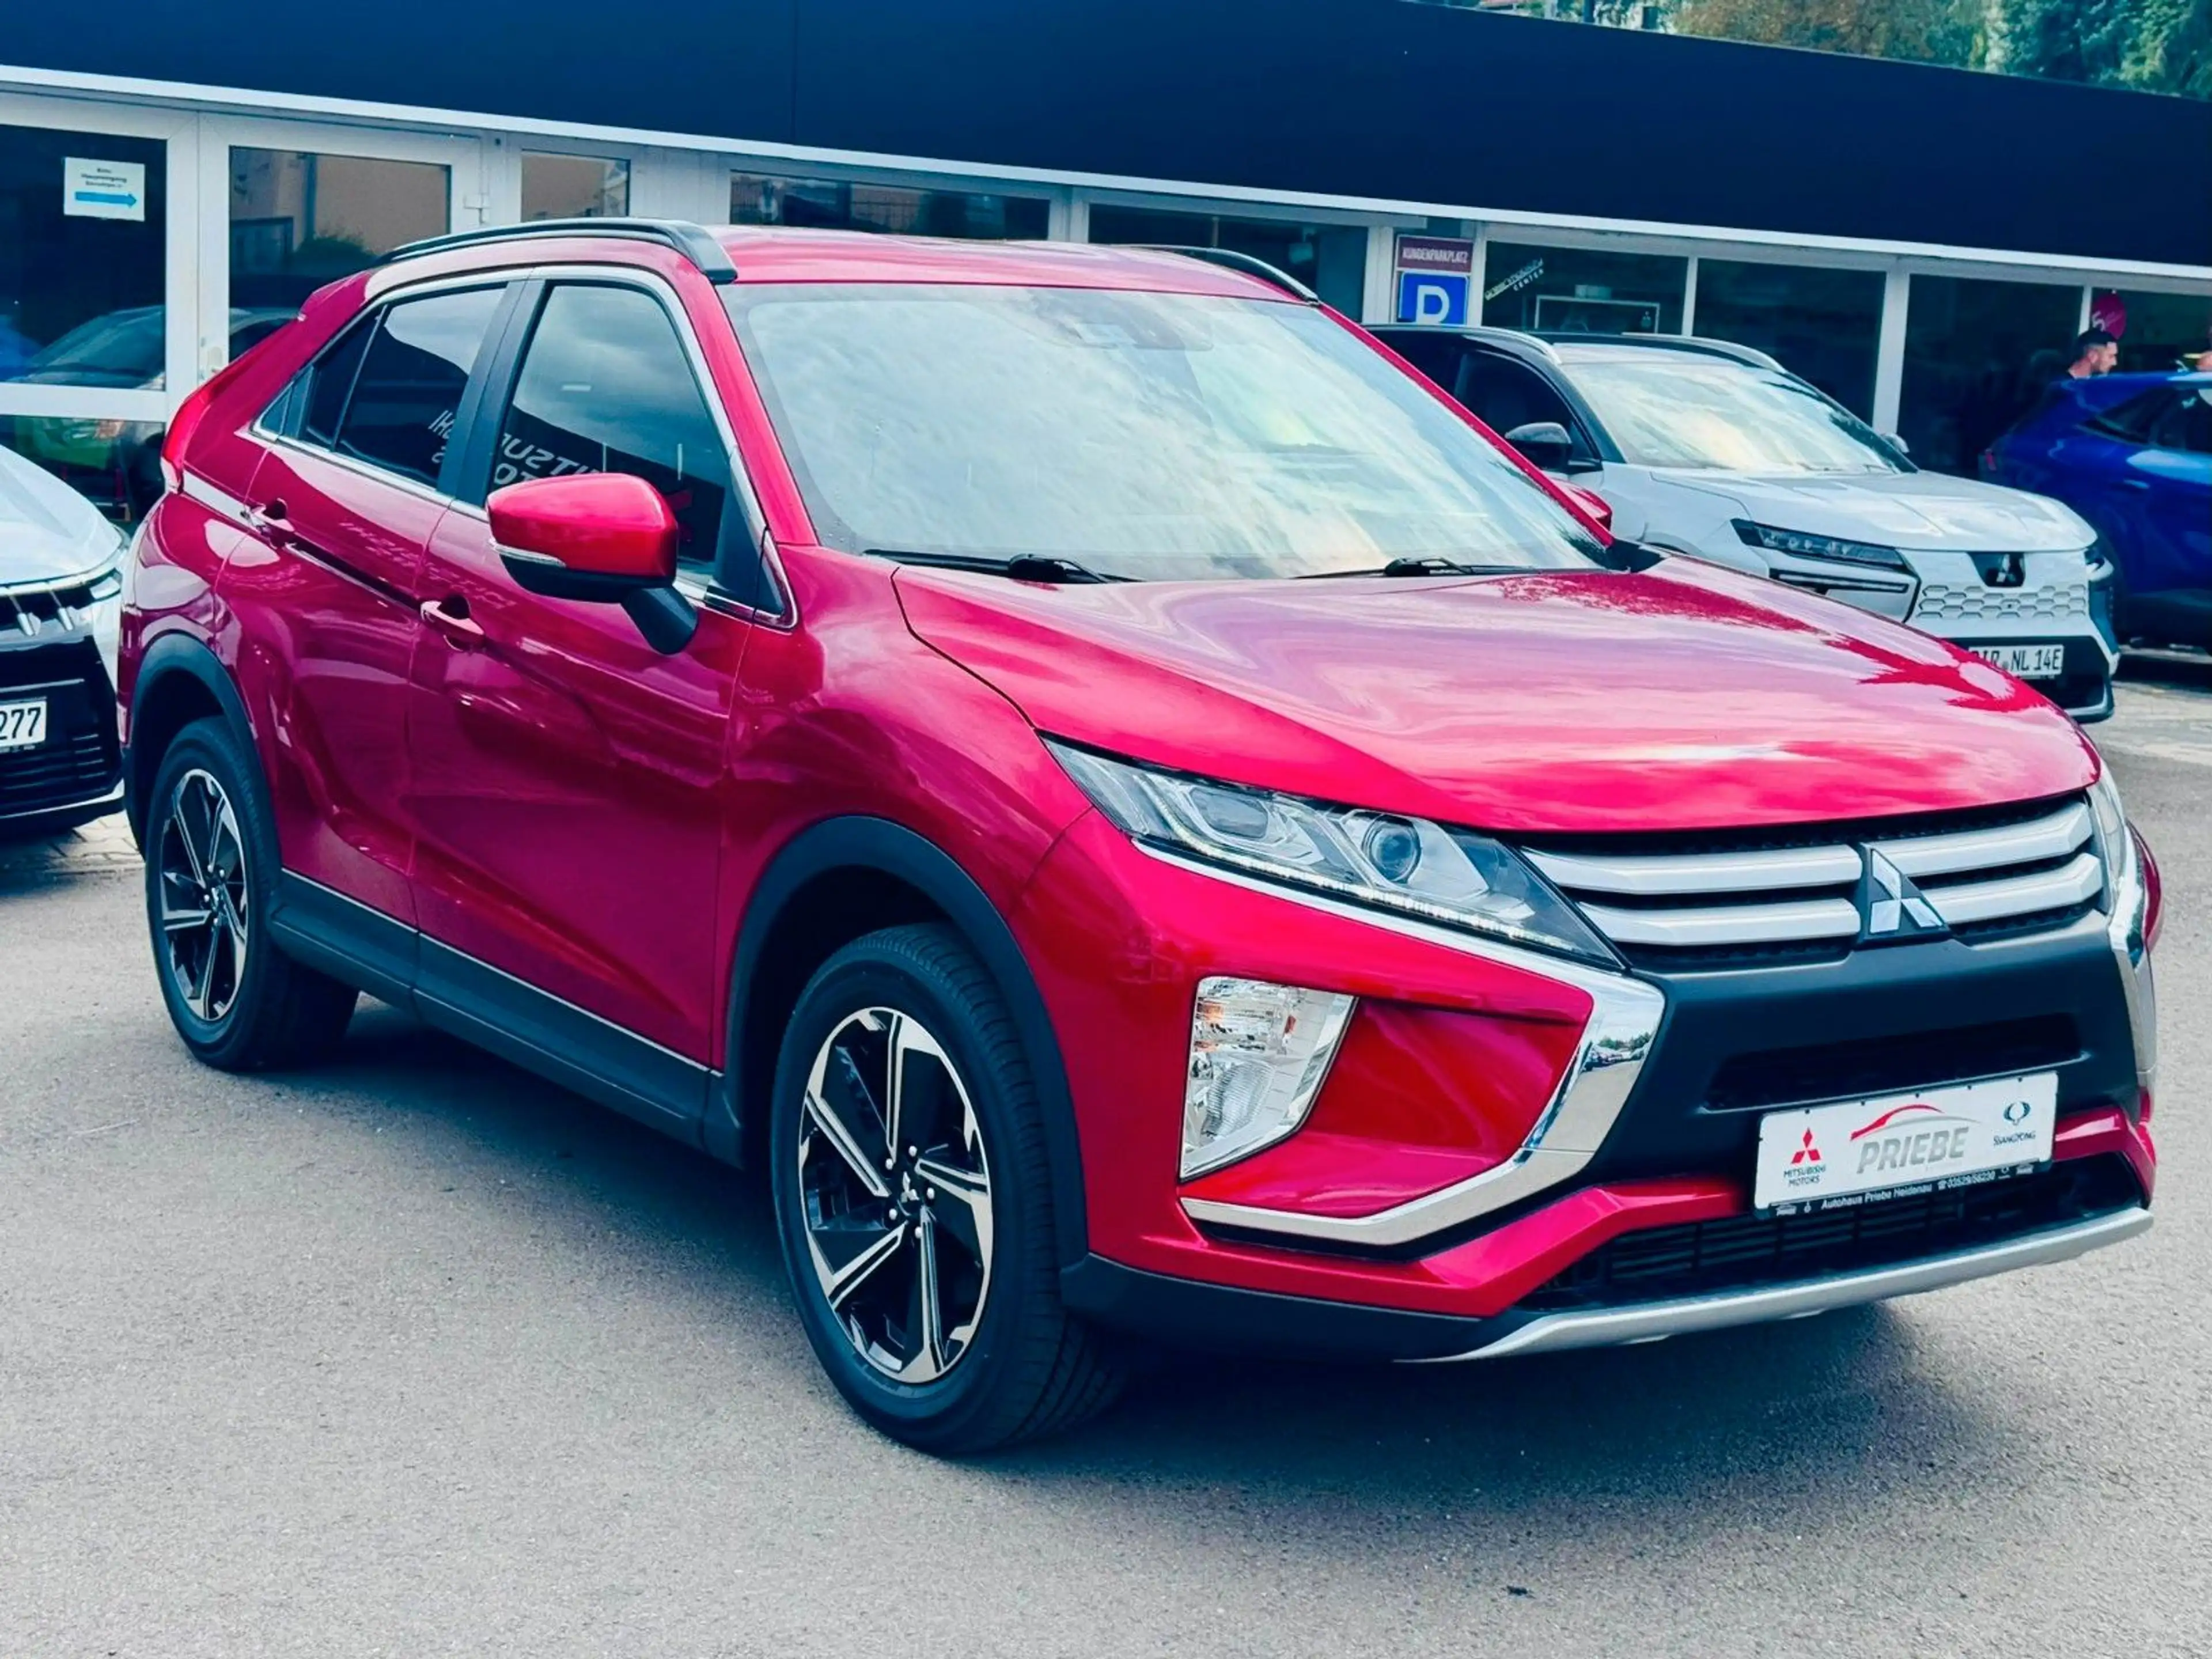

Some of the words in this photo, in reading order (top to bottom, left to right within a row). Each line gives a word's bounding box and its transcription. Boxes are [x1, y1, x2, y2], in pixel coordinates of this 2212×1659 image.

[1416, 285, 1450, 325] P
[2012, 650, 2029, 671] NL
[2033, 648, 2061, 671] 14E
[1857, 1127, 1969, 1174] PRIEBE
[1789, 1175, 1820, 1187] MOTORS
[1821, 1190, 1863, 1209] Autohaus
[1865, 1190, 1892, 1203] Priebe
